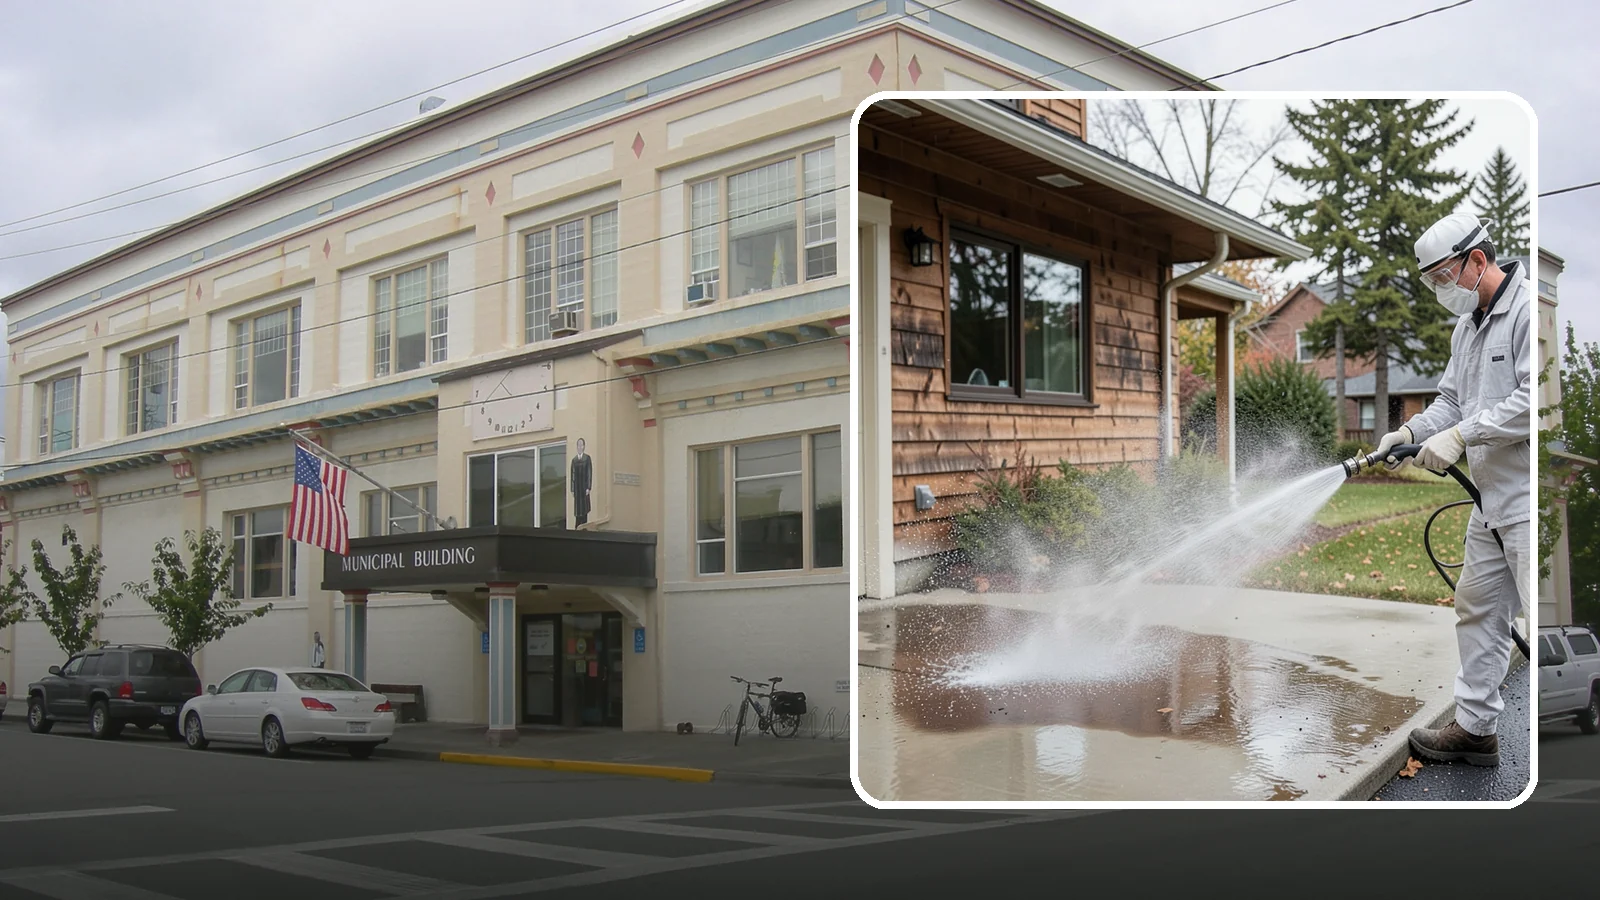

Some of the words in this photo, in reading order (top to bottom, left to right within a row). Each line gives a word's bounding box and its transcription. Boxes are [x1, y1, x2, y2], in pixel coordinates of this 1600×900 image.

[546, 361, 551, 370] 6
[480, 407, 485, 415] 8
[488, 418, 492, 426] 9
[529, 414, 533, 422] 3
[495, 424, 500, 432] 10
[342, 553, 405, 572] MUNICIPAL
[414, 546, 475, 567] BUILDING
